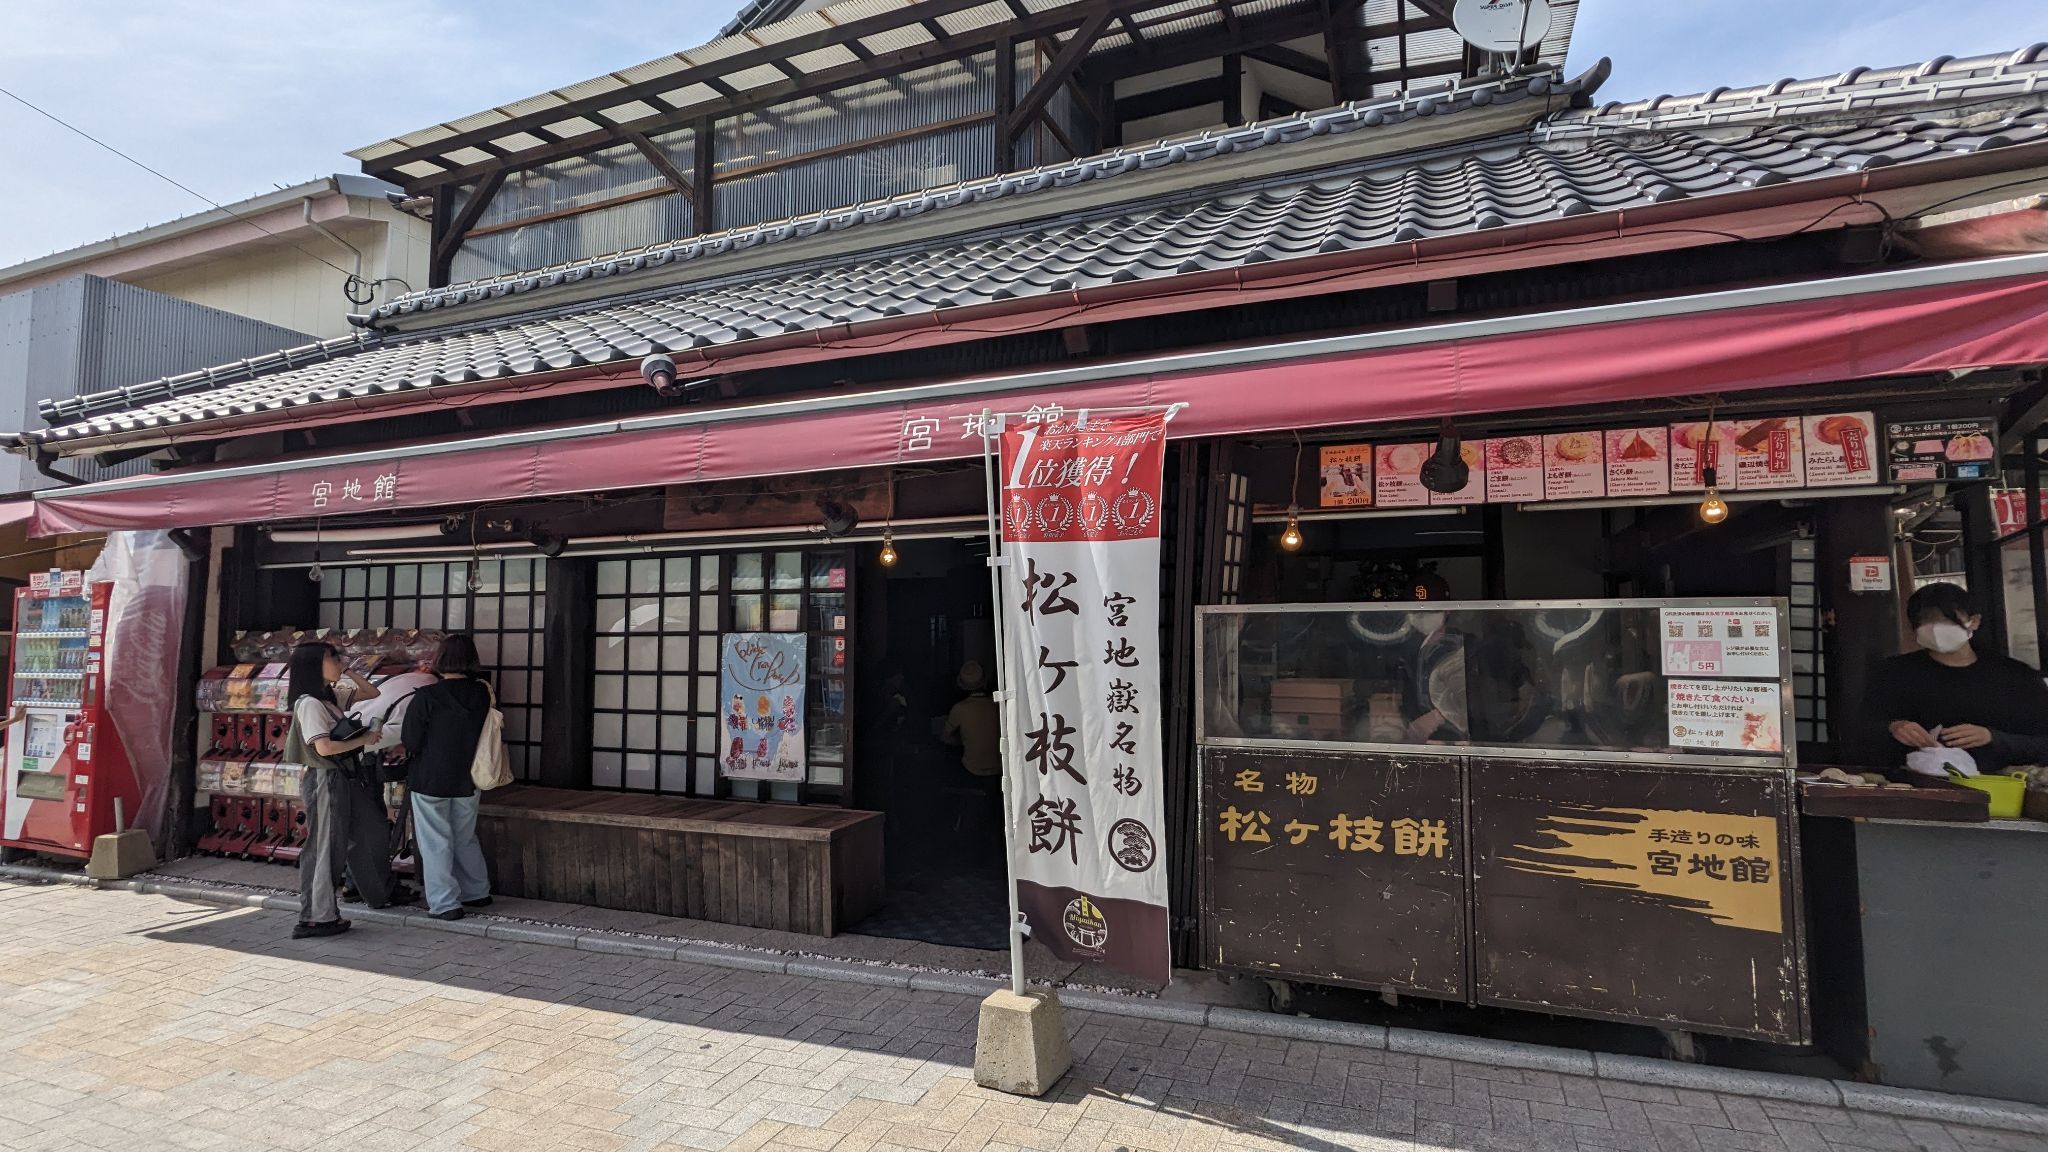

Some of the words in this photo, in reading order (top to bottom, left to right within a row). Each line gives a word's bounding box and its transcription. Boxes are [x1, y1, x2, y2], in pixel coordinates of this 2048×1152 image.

[312, 473, 396, 507] 宮地館
[1698, 662, 1715, 671] 5円
[1103, 591, 1143, 797] 宮地嶽名物
[1233, 769, 1318, 795] 名物
[1648, 829, 1760, 849] 手造りの味
[1647, 850, 1771, 884] 宮地館
